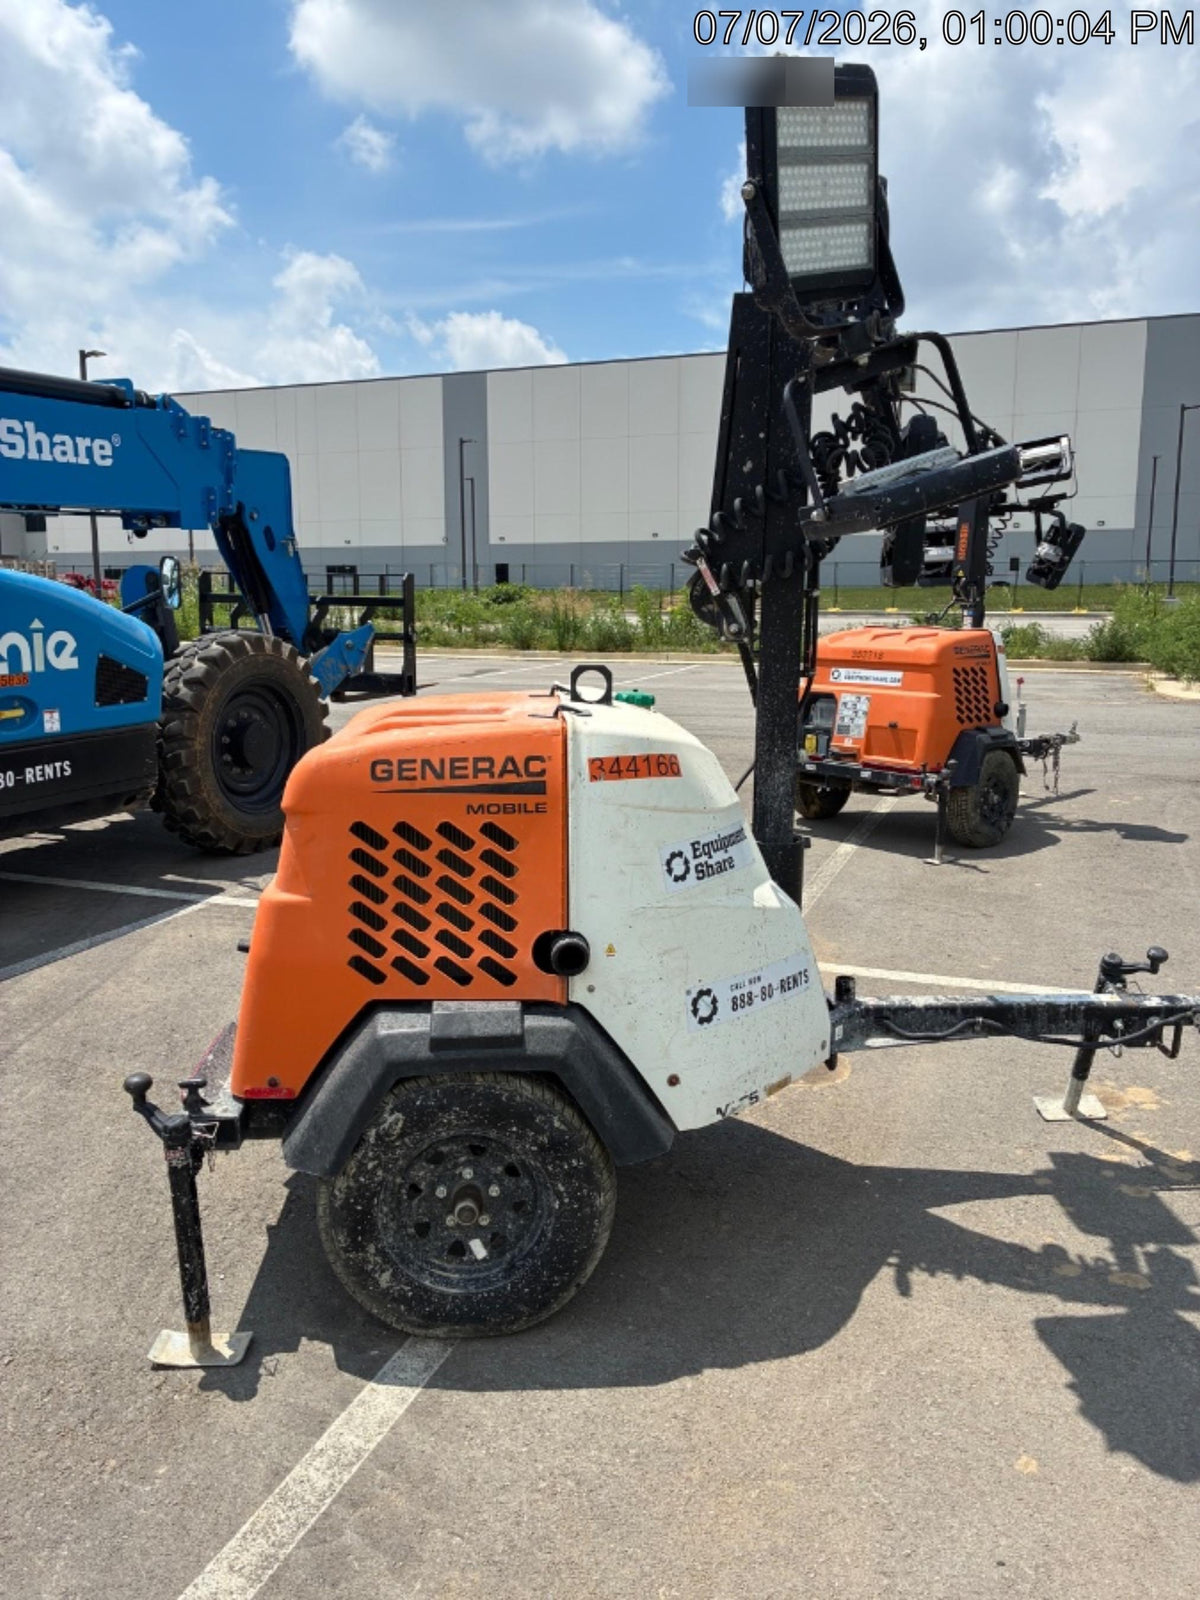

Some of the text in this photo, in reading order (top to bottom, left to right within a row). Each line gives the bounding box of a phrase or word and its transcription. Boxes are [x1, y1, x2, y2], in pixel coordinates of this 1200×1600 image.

[370, 755, 547, 782] GENERAC
[590, 753, 681, 781] 344166
[466, 802, 548, 815] MOBILE
[690, 827, 747, 859] Equipment
[694, 856, 735, 881] Share
[731, 968, 810, 1013] 888-80-RENTS
